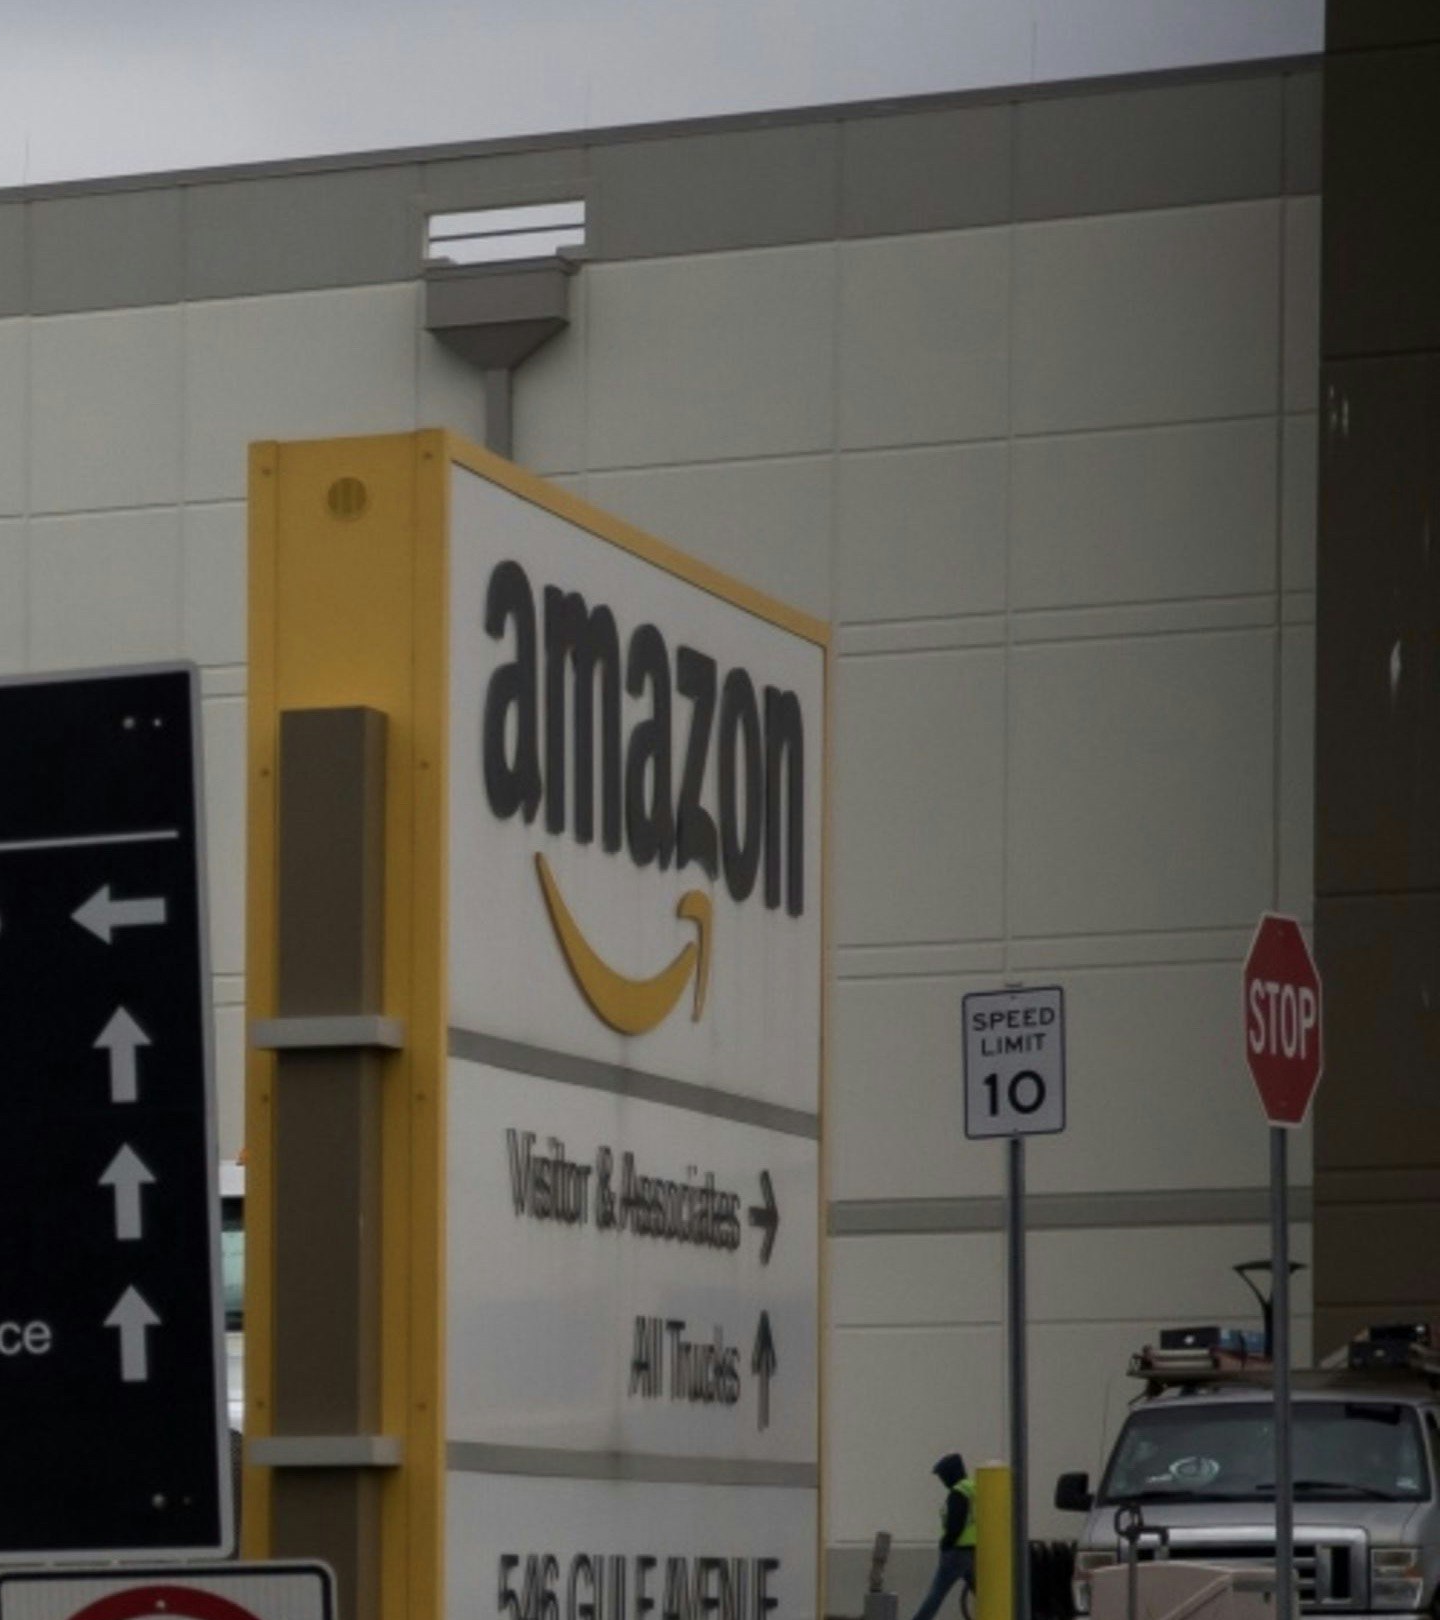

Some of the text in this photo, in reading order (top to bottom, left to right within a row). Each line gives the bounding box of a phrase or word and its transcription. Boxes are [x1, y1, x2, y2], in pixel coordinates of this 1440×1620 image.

[484, 560, 804, 917] amazon
[973, 1007, 1056, 1031] SPEED
[981, 1033, 1047, 1057] LIMIT
[1249, 978, 1317, 1060] STOP
[983, 1069, 1046, 1117] 10
[506, 1128, 741, 1252] Visitor & Associates
[629, 1315, 741, 1406] All Trucks
